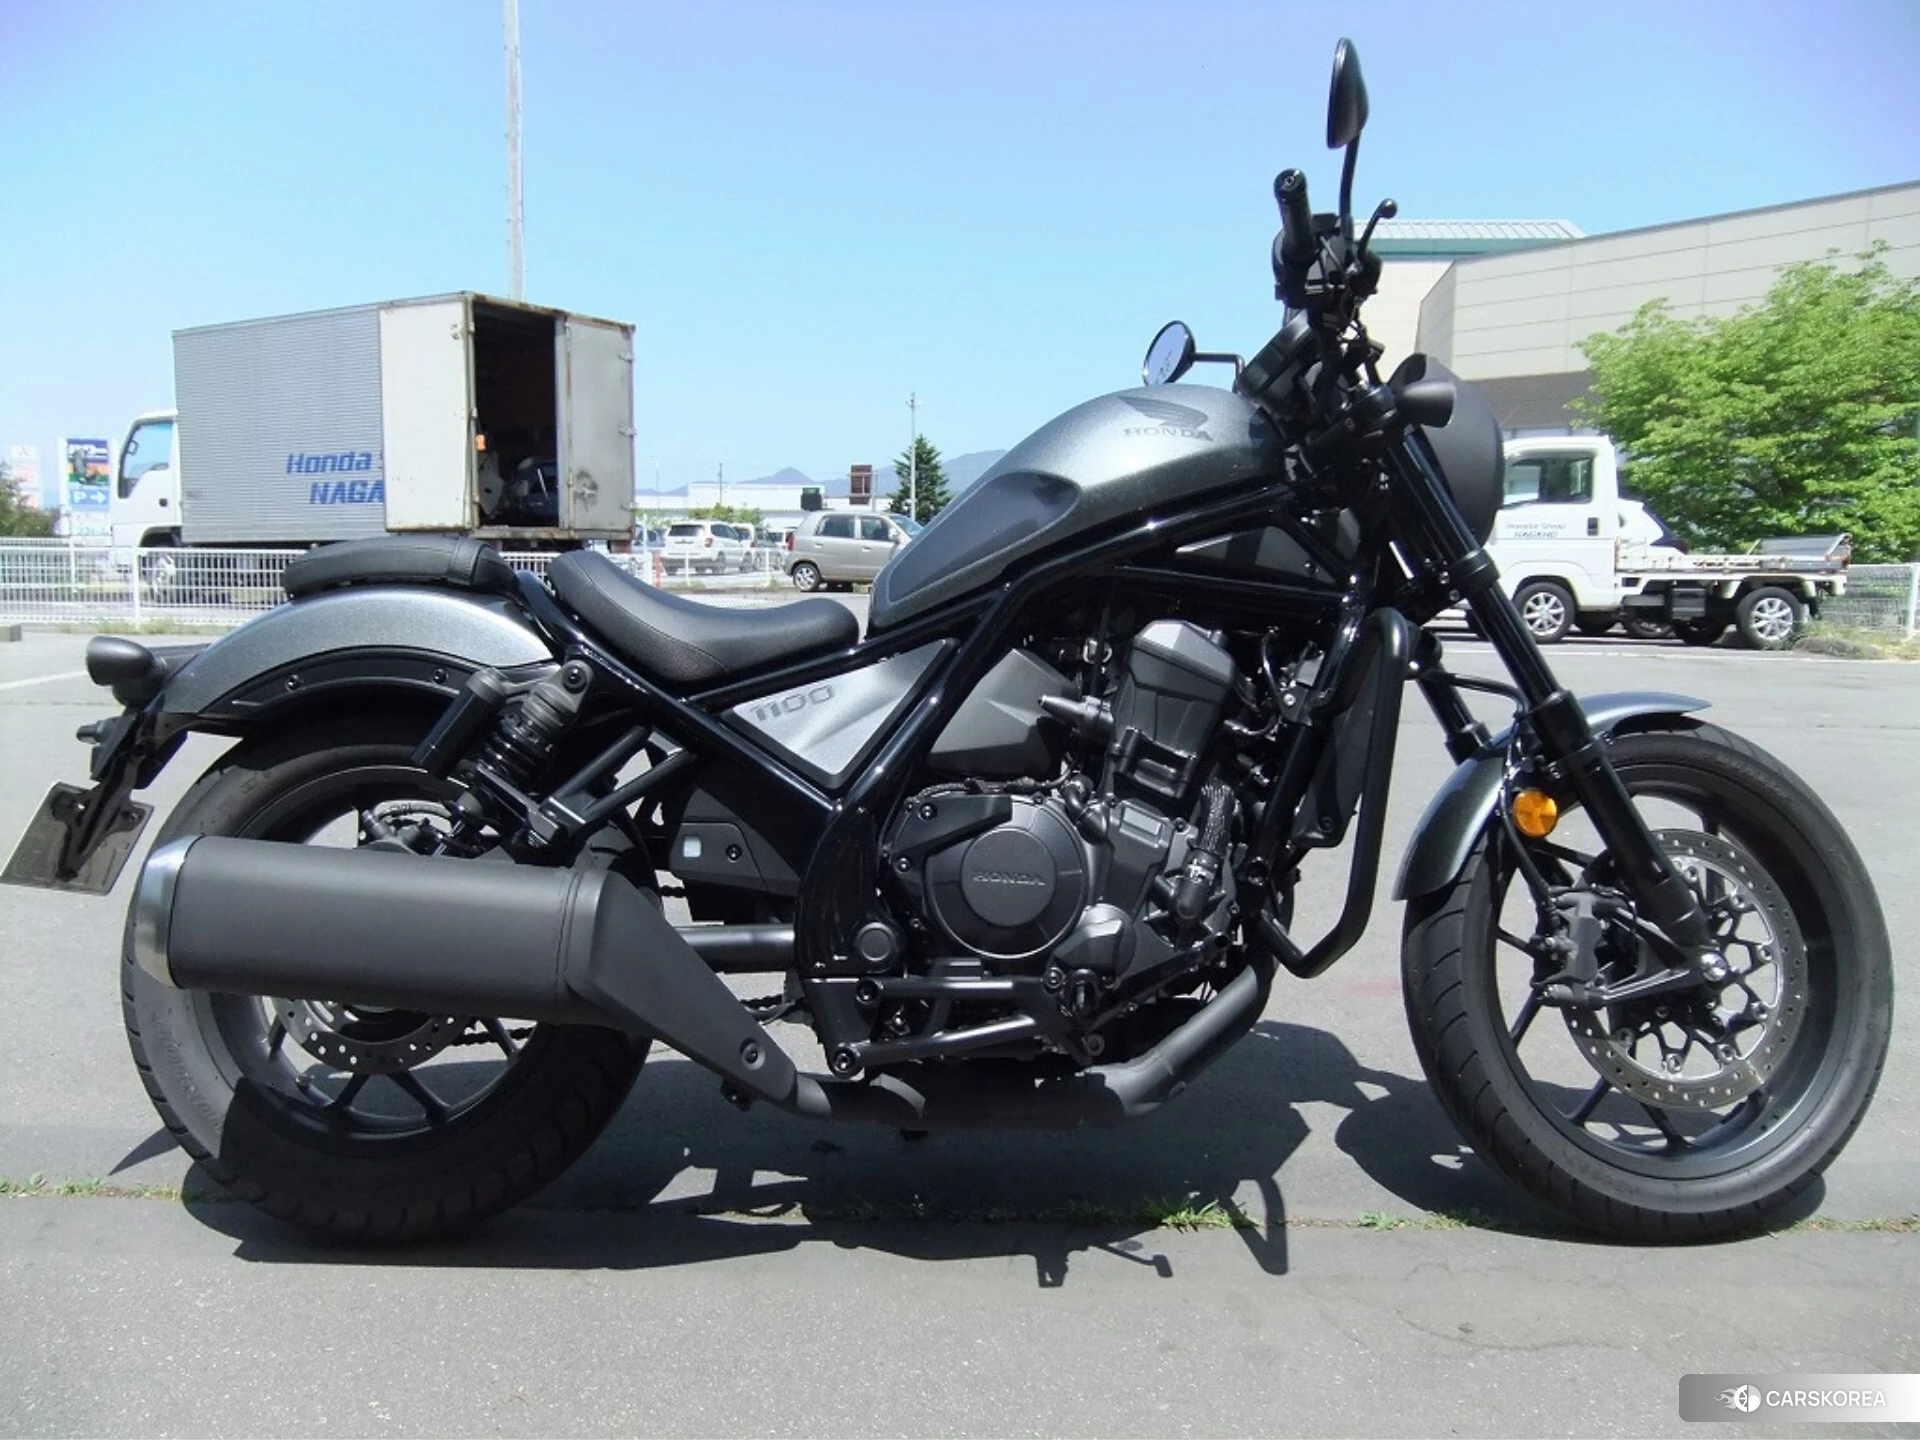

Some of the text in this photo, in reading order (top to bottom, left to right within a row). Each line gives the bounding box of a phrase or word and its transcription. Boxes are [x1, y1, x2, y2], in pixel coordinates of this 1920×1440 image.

[1123, 426, 1214, 442] HONDA
[286, 451, 372, 475] Honda
[749, 683, 834, 721] 1100
[972, 869, 1047, 887] HONDA
